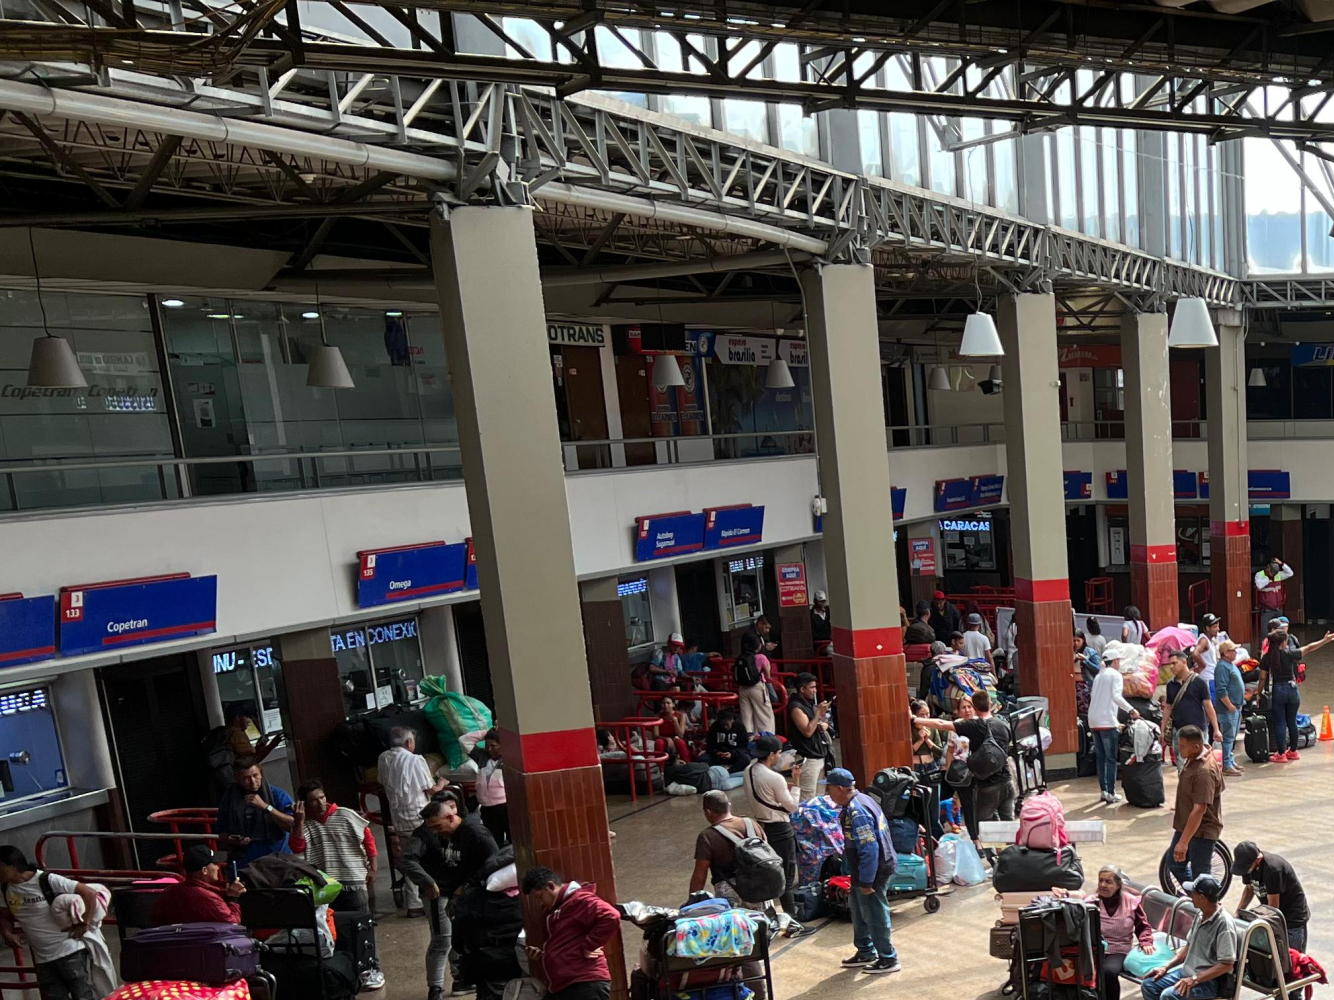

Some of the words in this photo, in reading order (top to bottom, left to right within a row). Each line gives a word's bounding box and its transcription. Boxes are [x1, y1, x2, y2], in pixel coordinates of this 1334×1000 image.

[728, 347, 756, 362] brasilia
[944, 520, 990, 531] CARACAS
[363, 568, 374, 577] 135
[389, 579, 411, 590] Omega
[65, 608, 80, 618] 133
[107, 618, 148, 633] Copetran
[347, 631, 365, 650] EN
[213, 652, 236, 673] INU
